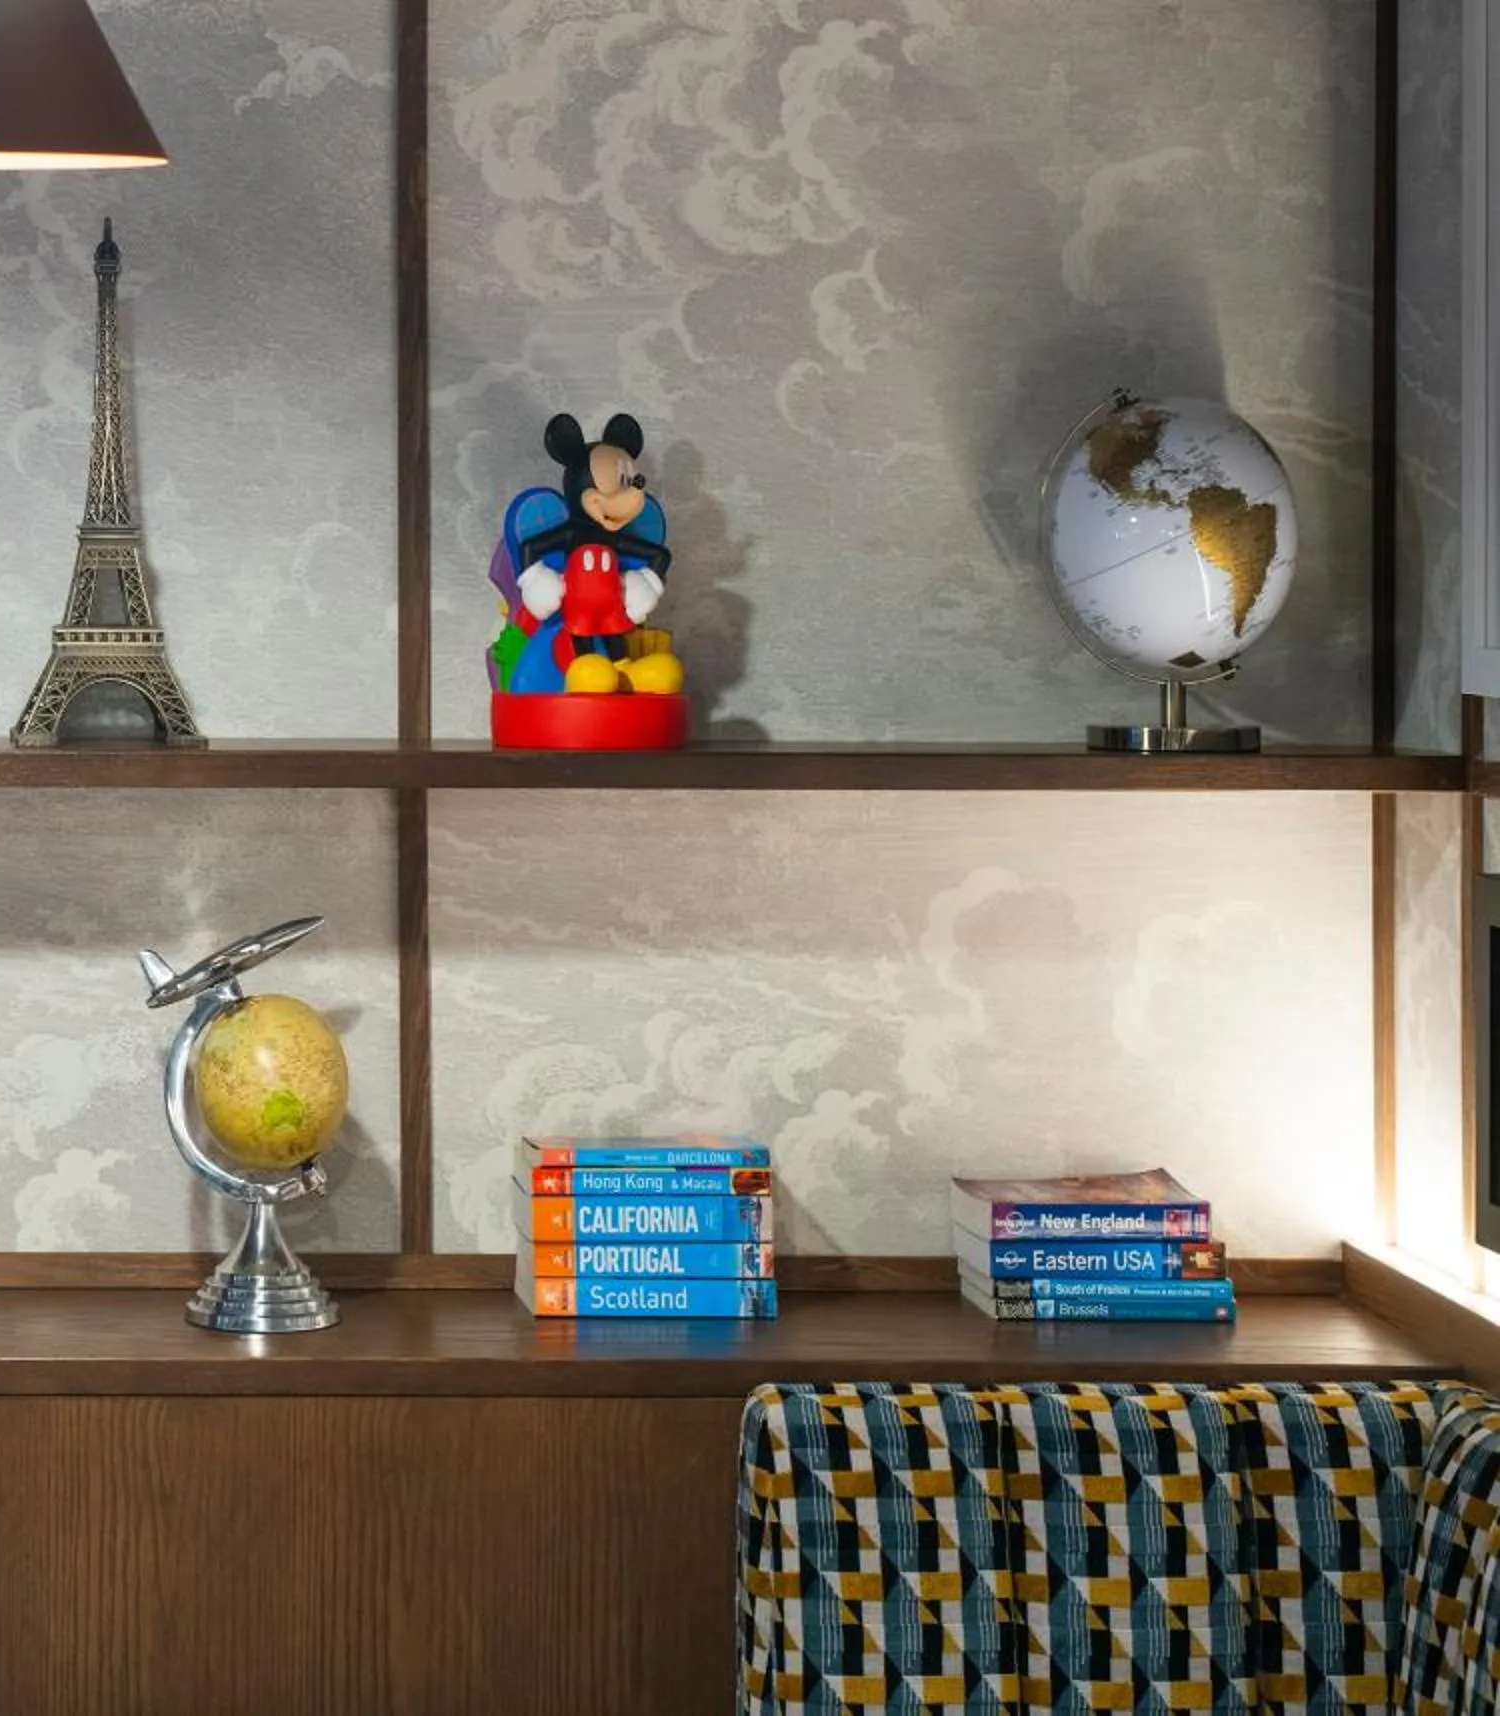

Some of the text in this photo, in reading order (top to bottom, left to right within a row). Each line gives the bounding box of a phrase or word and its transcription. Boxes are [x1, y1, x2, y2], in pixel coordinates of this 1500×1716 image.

[667, 1152, 732, 1164] BARCELONA
[583, 1174, 723, 1192] Hong Kong & Macau
[579, 1206, 699, 1234] CALIFORNIA
[1040, 1212, 1145, 1233] New England
[579, 1247, 685, 1274] PORTUGAL
[1032, 1250, 1156, 1271] Eastern USA
[590, 1286, 688, 1310] Scotland
[1055, 1284, 1085, 1296] South
[1086, 1285, 1097, 1296] of
[1098, 1285, 1131, 1296] France
[1059, 1303, 1109, 1316] Brussels
